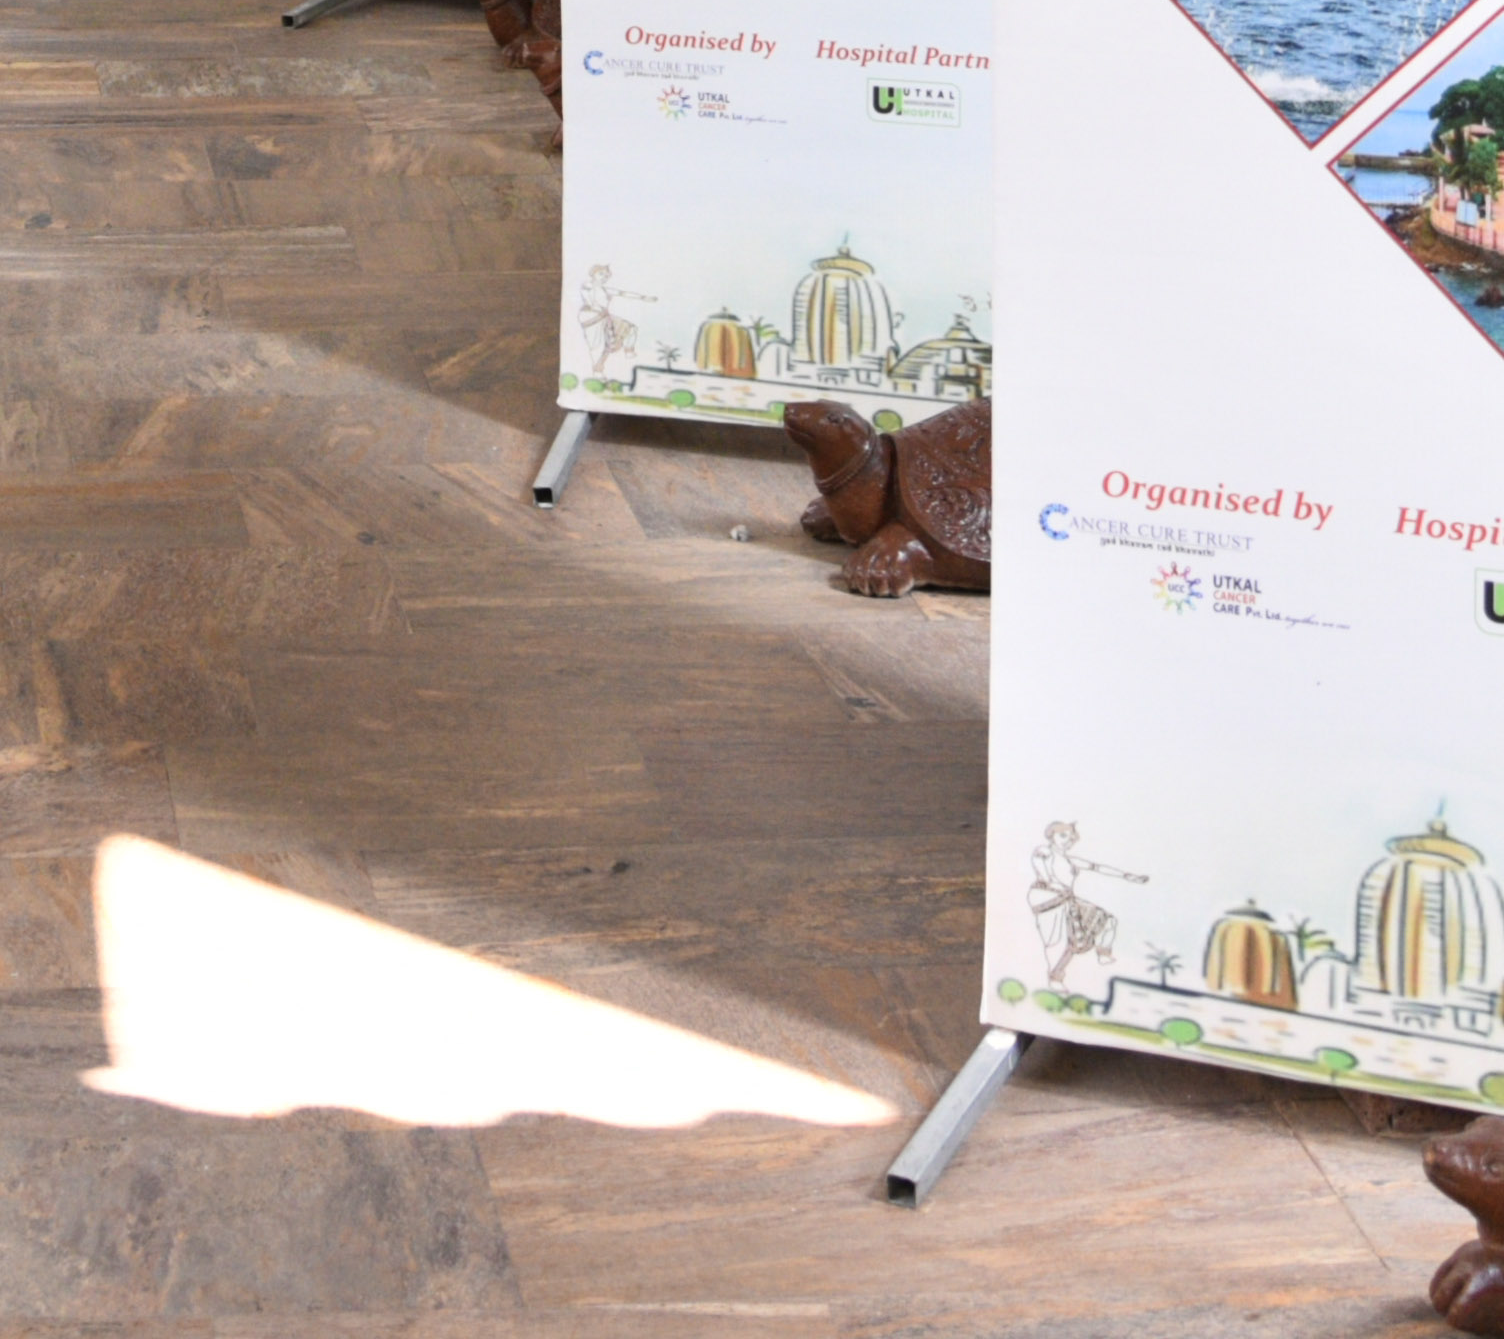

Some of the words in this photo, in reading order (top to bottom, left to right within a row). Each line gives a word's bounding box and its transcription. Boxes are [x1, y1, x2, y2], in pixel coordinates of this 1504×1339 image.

[625, 26, 744, 52] Organised
[751, 33, 776, 59] by
[817, 40, 917, 67] Hospital
[924, 47, 989, 69] Partn
[698, 92, 730, 103] UTKAL
[903, 87, 955, 100] UTKAL
[1102, 471, 1283, 517] Organised
[1294, 492, 1332, 530] by
[1138, 521, 1188, 542] CURE
[1194, 529, 1254, 551] TRUST
[1213, 575, 1261, 593] UTKAL
[1213, 590, 1256, 605] CANCER
[1213, 603, 1240, 616] CARE
